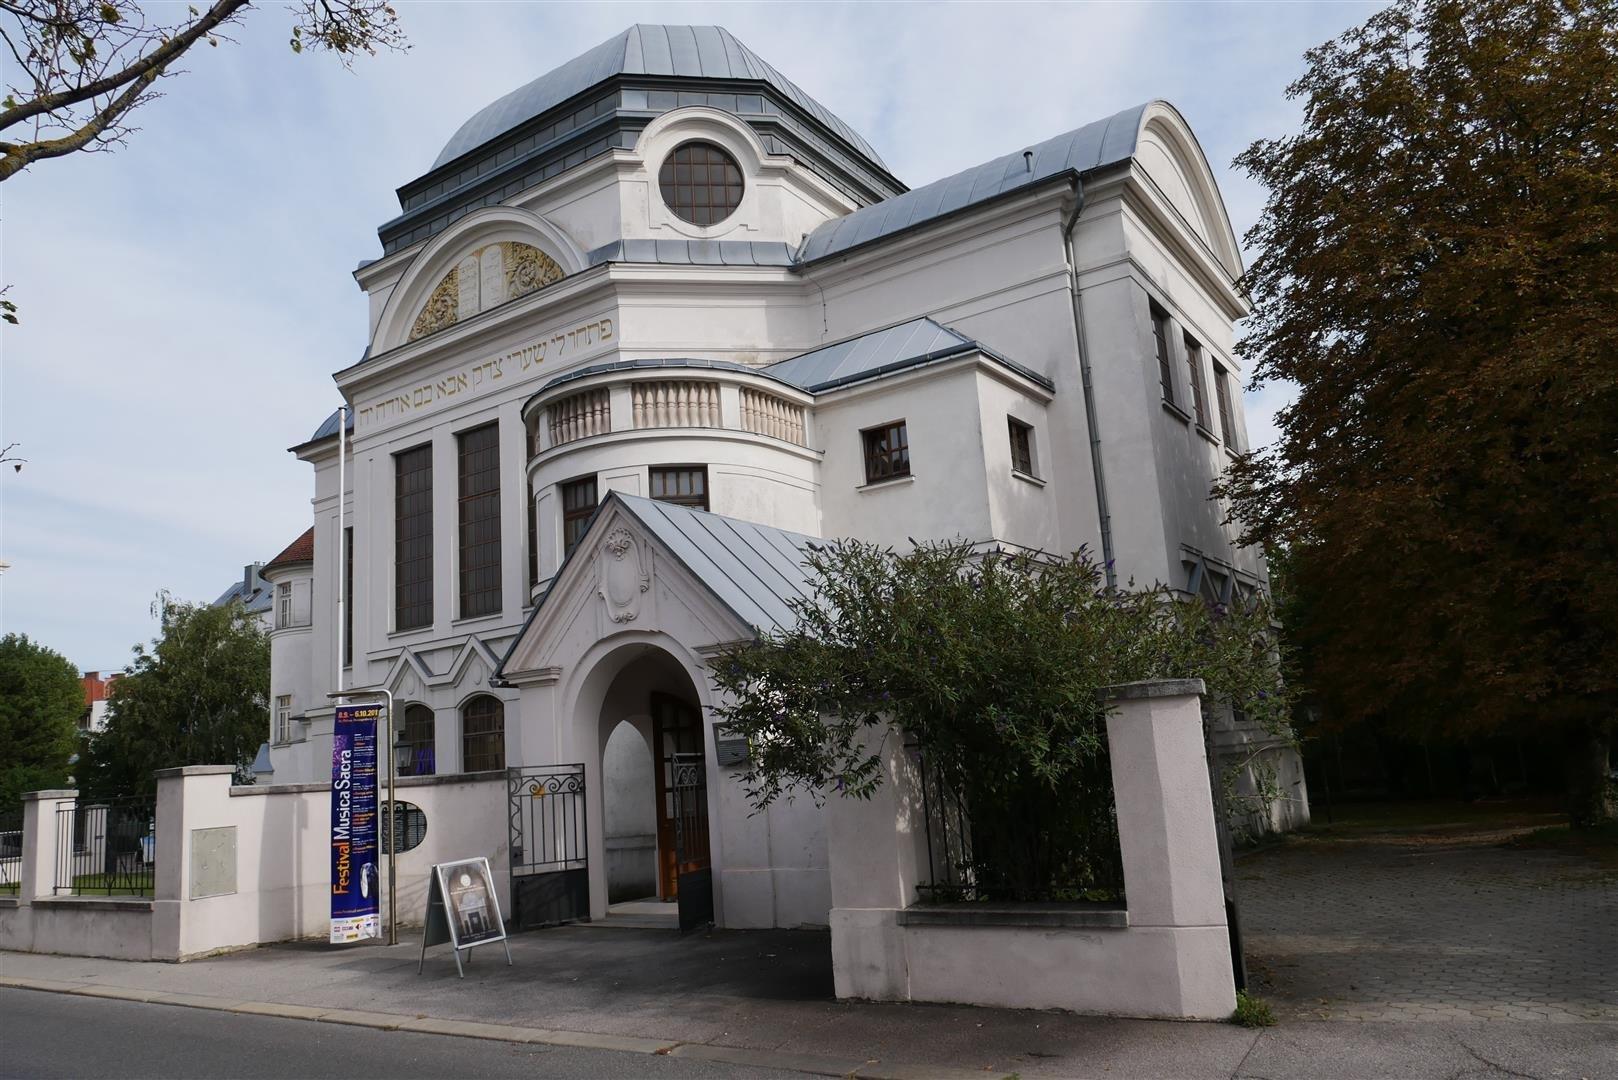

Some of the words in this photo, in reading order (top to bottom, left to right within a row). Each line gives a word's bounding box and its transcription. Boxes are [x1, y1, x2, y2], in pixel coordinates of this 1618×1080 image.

[551, 333, 566, 356] לי
[567, 318, 613, 349] פתחו
[506, 341, 547, 371] שערי
[472, 358, 503, 392] צדק
[359, 407, 373, 426] יה
[354, 709, 378, 718] 6.10.201
[333, 842, 351, 895] Festival
